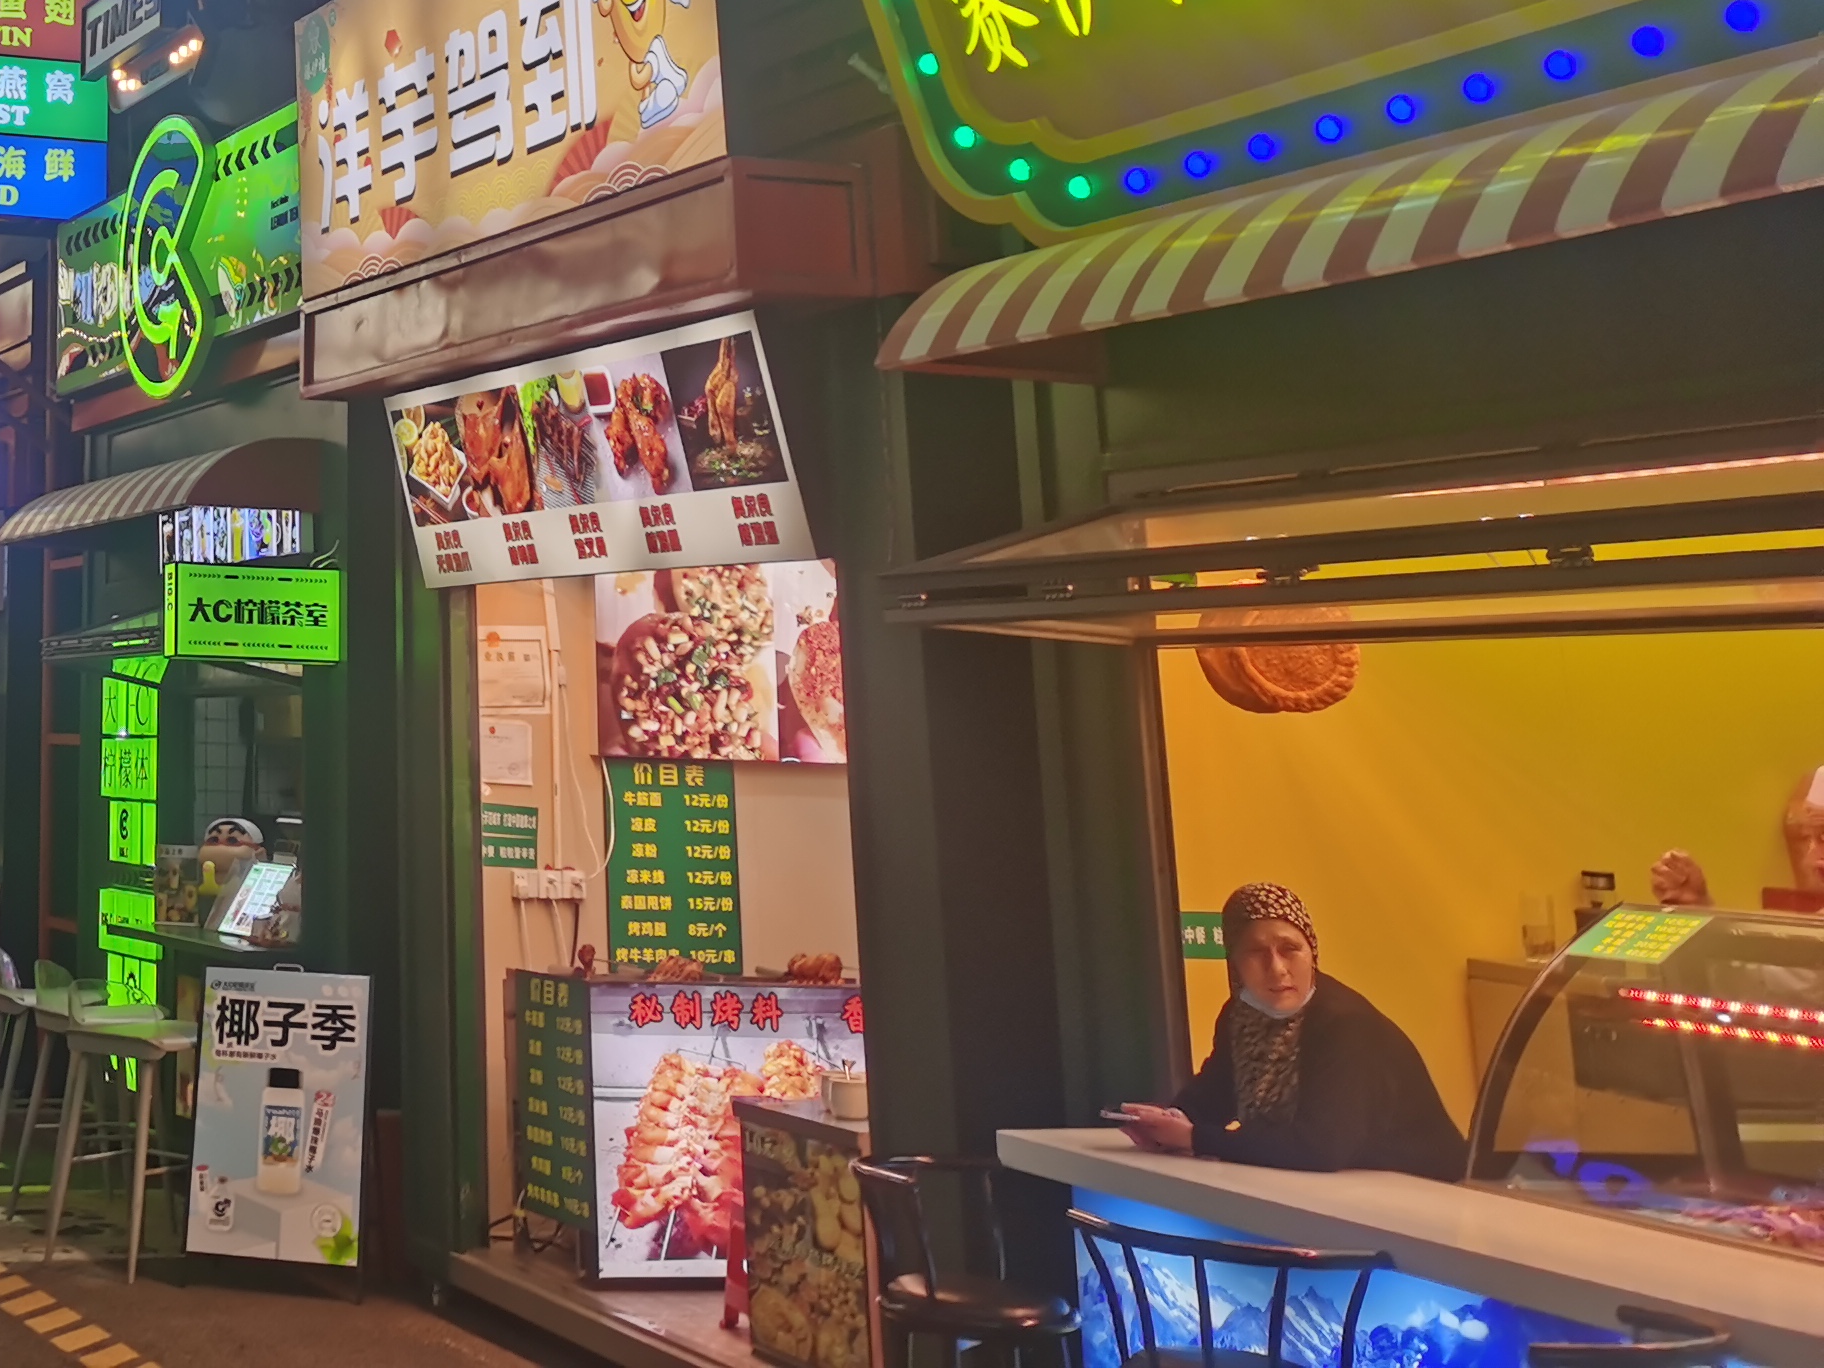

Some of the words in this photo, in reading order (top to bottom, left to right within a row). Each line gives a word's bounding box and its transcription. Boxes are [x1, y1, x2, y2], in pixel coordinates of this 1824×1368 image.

[187, 596, 330, 629] 大C柠檬茶室
[632, 761, 706, 787] 价目表
[683, 792, 729, 809] 12元/份
[630, 816, 658, 834] 凉皮
[684, 818, 731, 835] 12元/份
[631, 842, 659, 859] 凉粉
[685, 844, 732, 861] 12元/份
[626, 868, 666, 886] 凉米线
[686, 870, 733, 887] 12元/份
[687, 895, 734, 913] 15元/份
[687, 921, 728, 939] 8元/个
[627, 992, 783, 1033] 秘制烤料
[215, 995, 358, 1052] 椰子季
